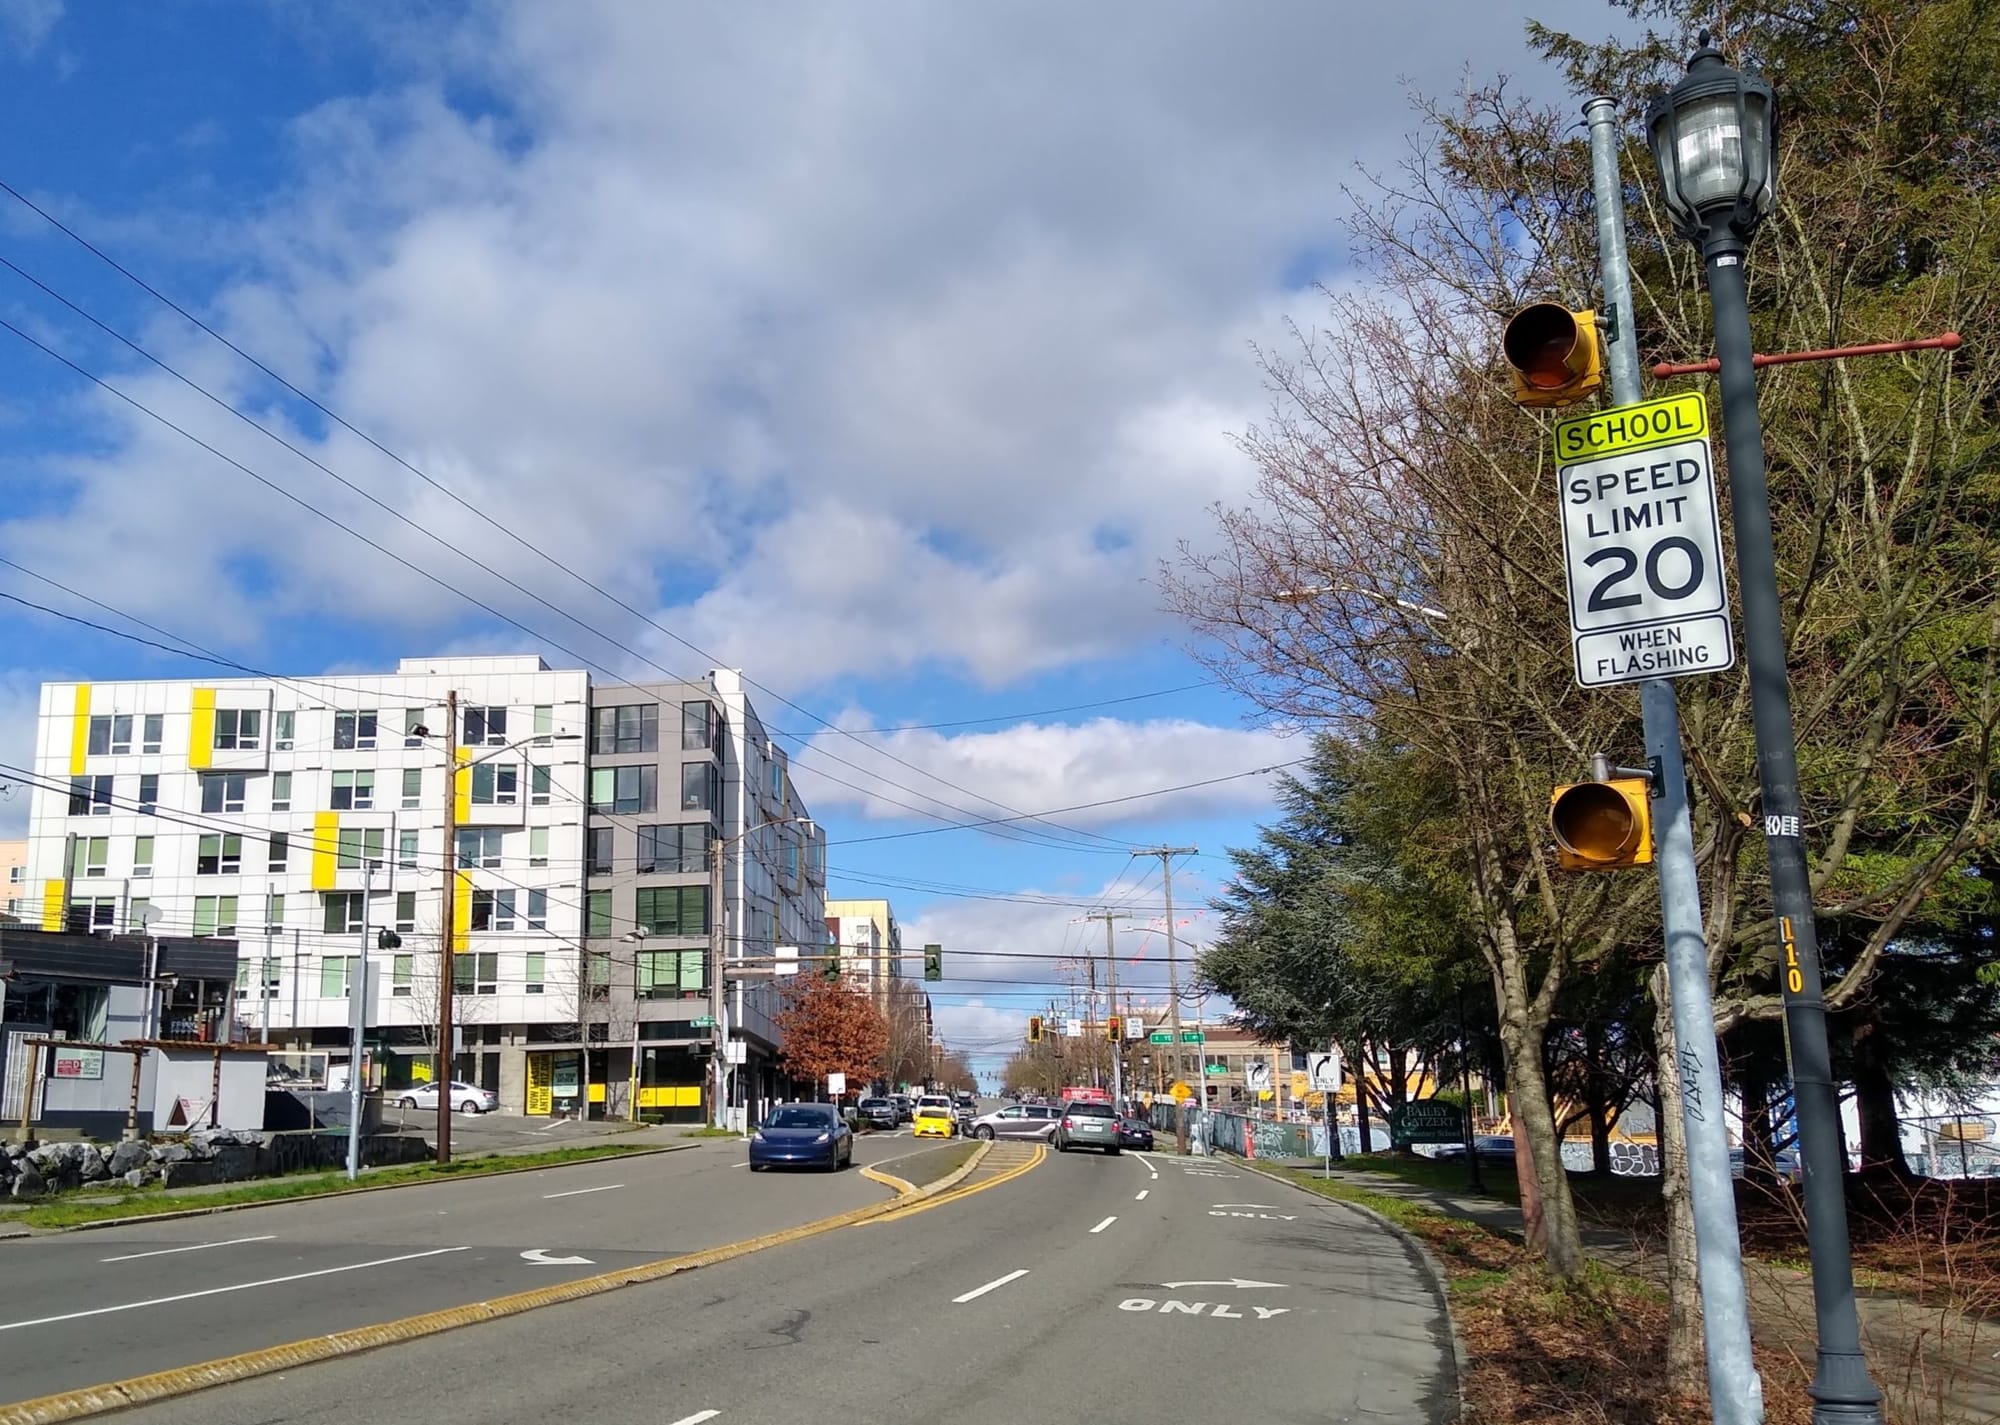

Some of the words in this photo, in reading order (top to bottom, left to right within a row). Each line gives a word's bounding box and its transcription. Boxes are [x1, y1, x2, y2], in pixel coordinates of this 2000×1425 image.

[1566, 406, 1694, 452] SCHOOL
[1570, 458, 1701, 505] SPEED
[1586, 496, 1688, 538] LIMIT
[1582, 536, 1704, 613] 20
[1618, 626, 1682, 651] WHEN
[1597, 645, 1709, 677] FLASHING
[1783, 916, 1803, 993] 110
[529, 1090, 539, 1109] NOW
[1406, 1105, 1448, 1117] BAILEY
[1401, 1116, 1456, 1128] GATZERT
[1207, 1211, 1298, 1220] ONLY
[1118, 1298, 1291, 1319] ONLY
